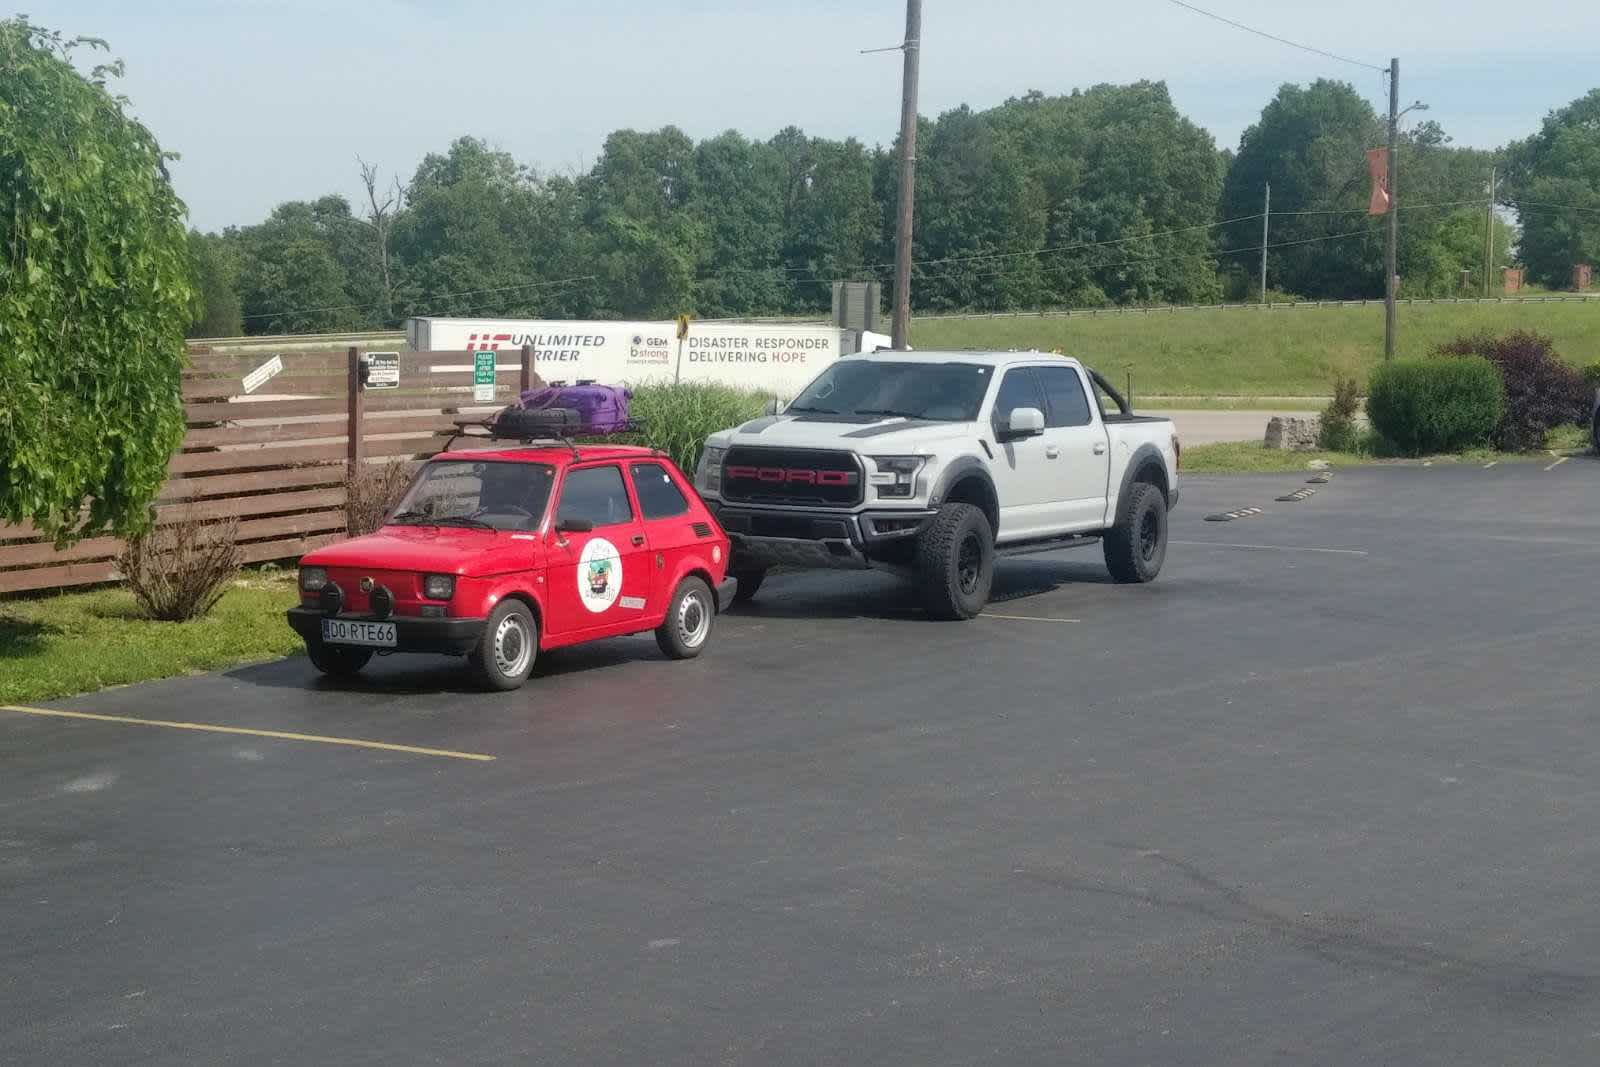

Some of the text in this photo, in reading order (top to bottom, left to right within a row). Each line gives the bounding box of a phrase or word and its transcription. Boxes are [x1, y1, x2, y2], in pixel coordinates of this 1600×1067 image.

[511, 334, 605, 347] UNLIMITED
[646, 337, 668, 346] GEM
[689, 337, 829, 350] DISASTER RESPONDER
[534, 350, 580, 361] RRIER
[689, 351, 806, 363] DELIVERING HOPE
[727, 465, 849, 487] FORD
[350, 623, 394, 641] RTE66
